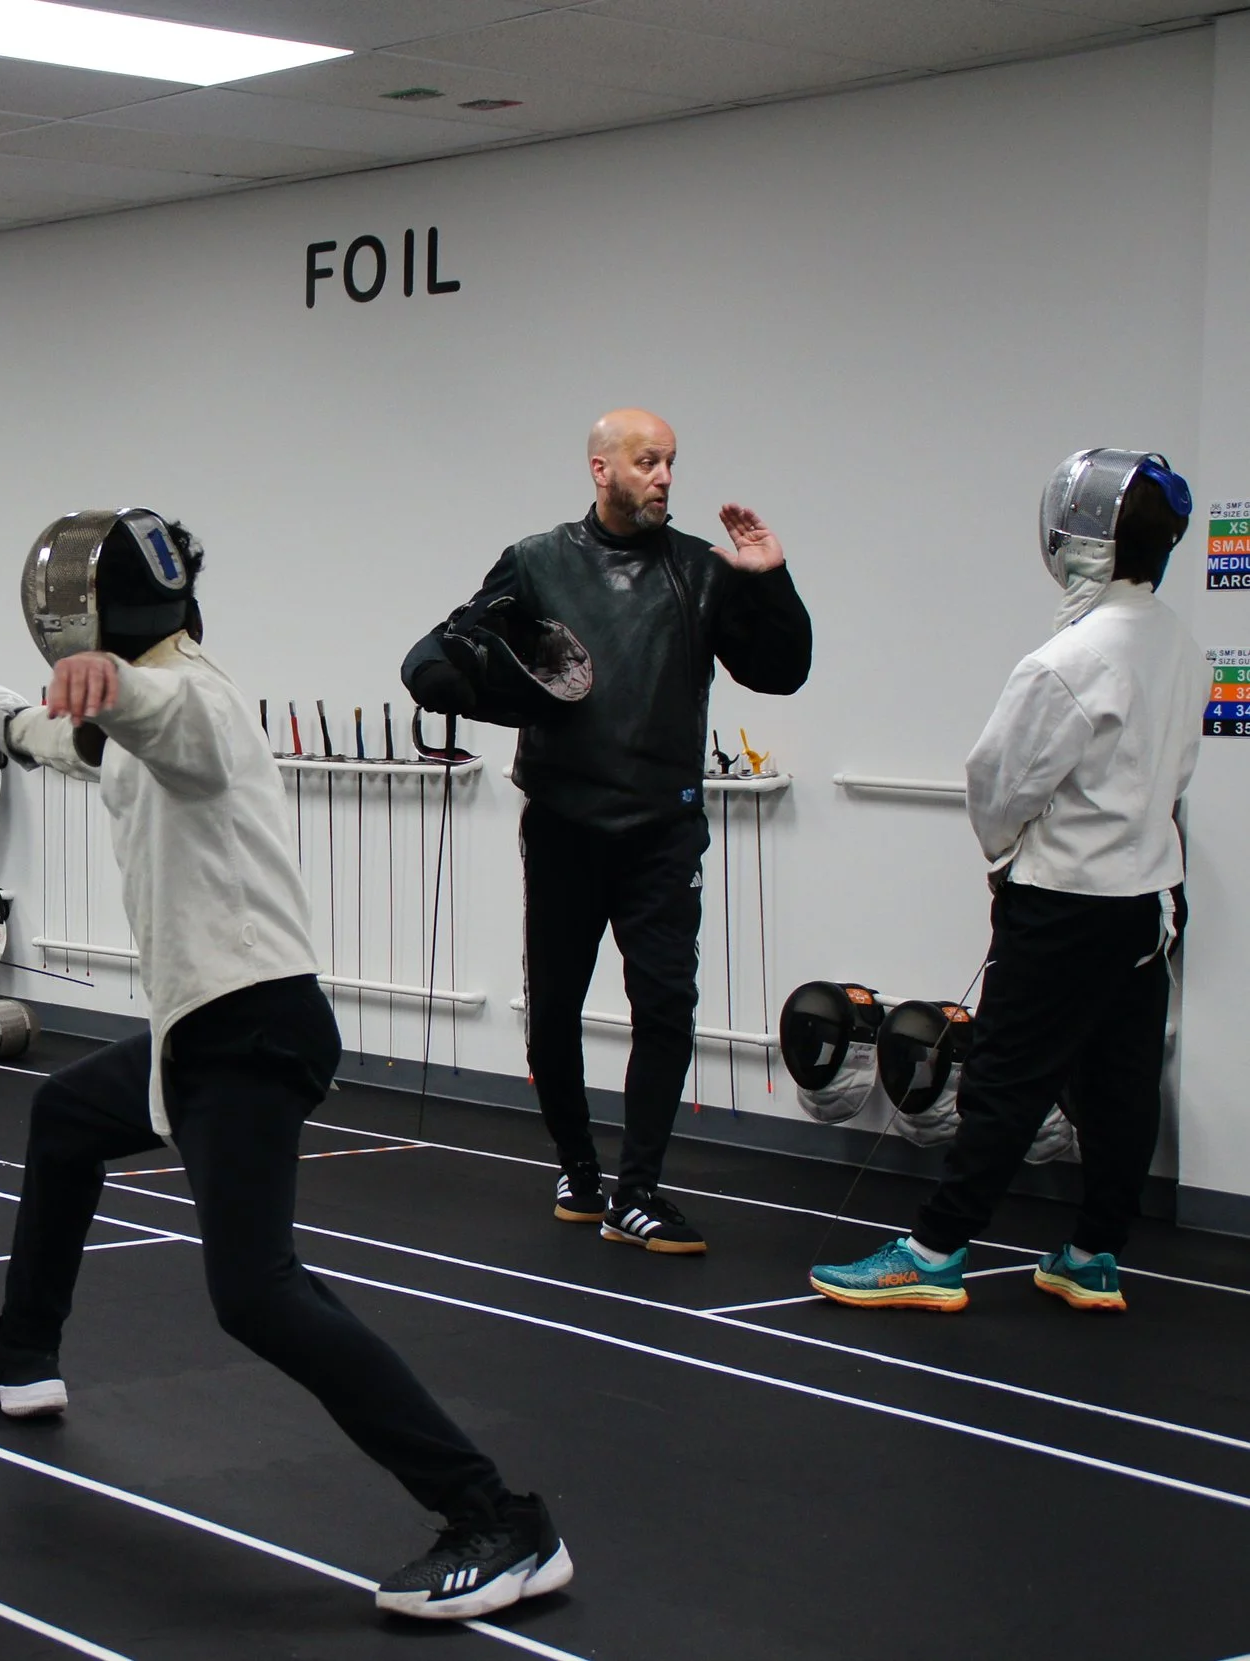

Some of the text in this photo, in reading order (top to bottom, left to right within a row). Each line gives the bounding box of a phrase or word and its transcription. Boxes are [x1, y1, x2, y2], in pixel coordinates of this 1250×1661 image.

[306, 226, 461, 309] FOIL
[1223, 510, 1241, 518] SIZE
[1229, 521, 1248, 534] XS
[1210, 574, 1250, 587] LARG
[1214, 686, 1222, 699] 2
[1213, 704, 1222, 716] 4
[1212, 721, 1221, 734] 5
[878, 1270, 919, 1288] HOKA
